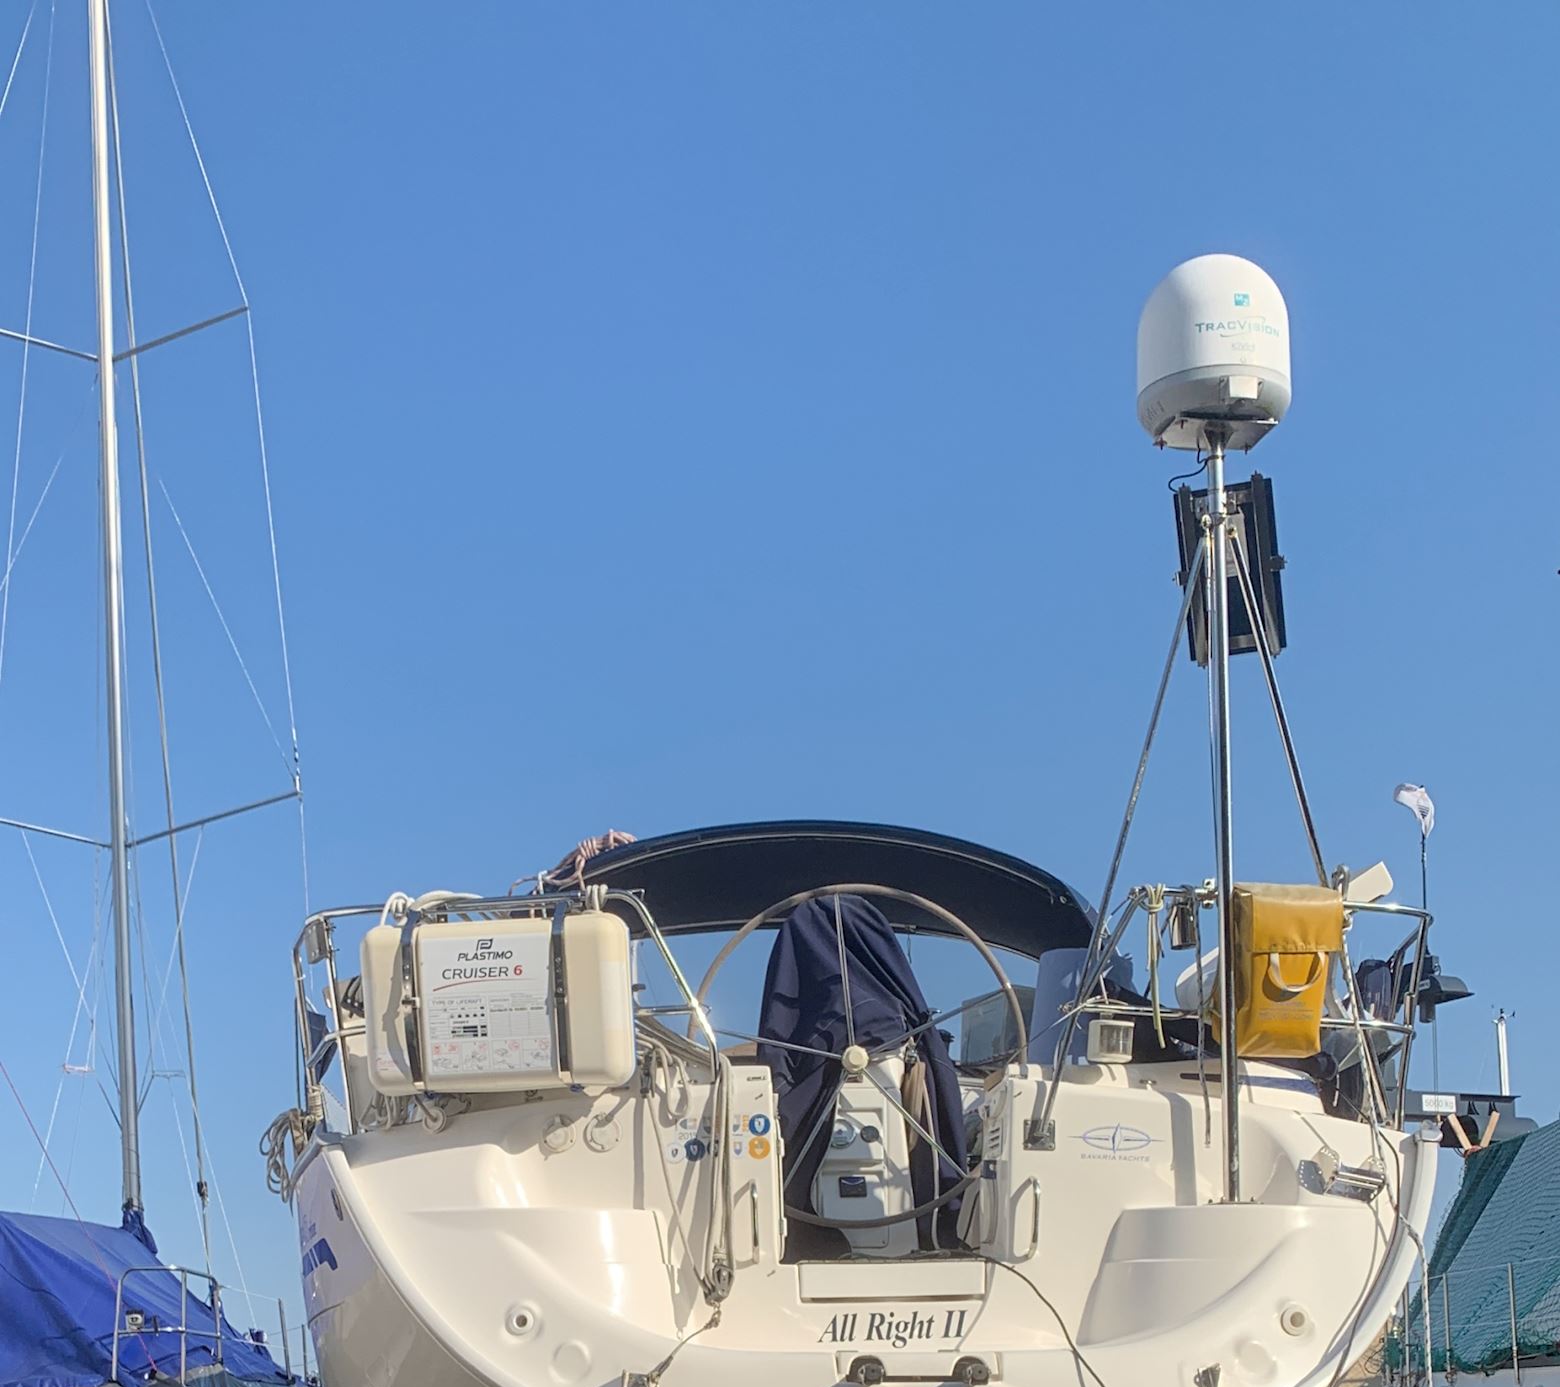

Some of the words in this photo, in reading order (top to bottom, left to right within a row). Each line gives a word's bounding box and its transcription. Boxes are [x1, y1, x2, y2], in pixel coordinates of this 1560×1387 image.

[457, 950, 513, 961] PLASTIMO
[442, 966, 509, 980] CRUISER
[513, 964, 523, 976] 6
[1080, 1153, 1117, 1161] BAVARIA
[817, 1313, 857, 1343] All
[864, 1311, 935, 1349] Right
[942, 1309, 969, 1338] II
